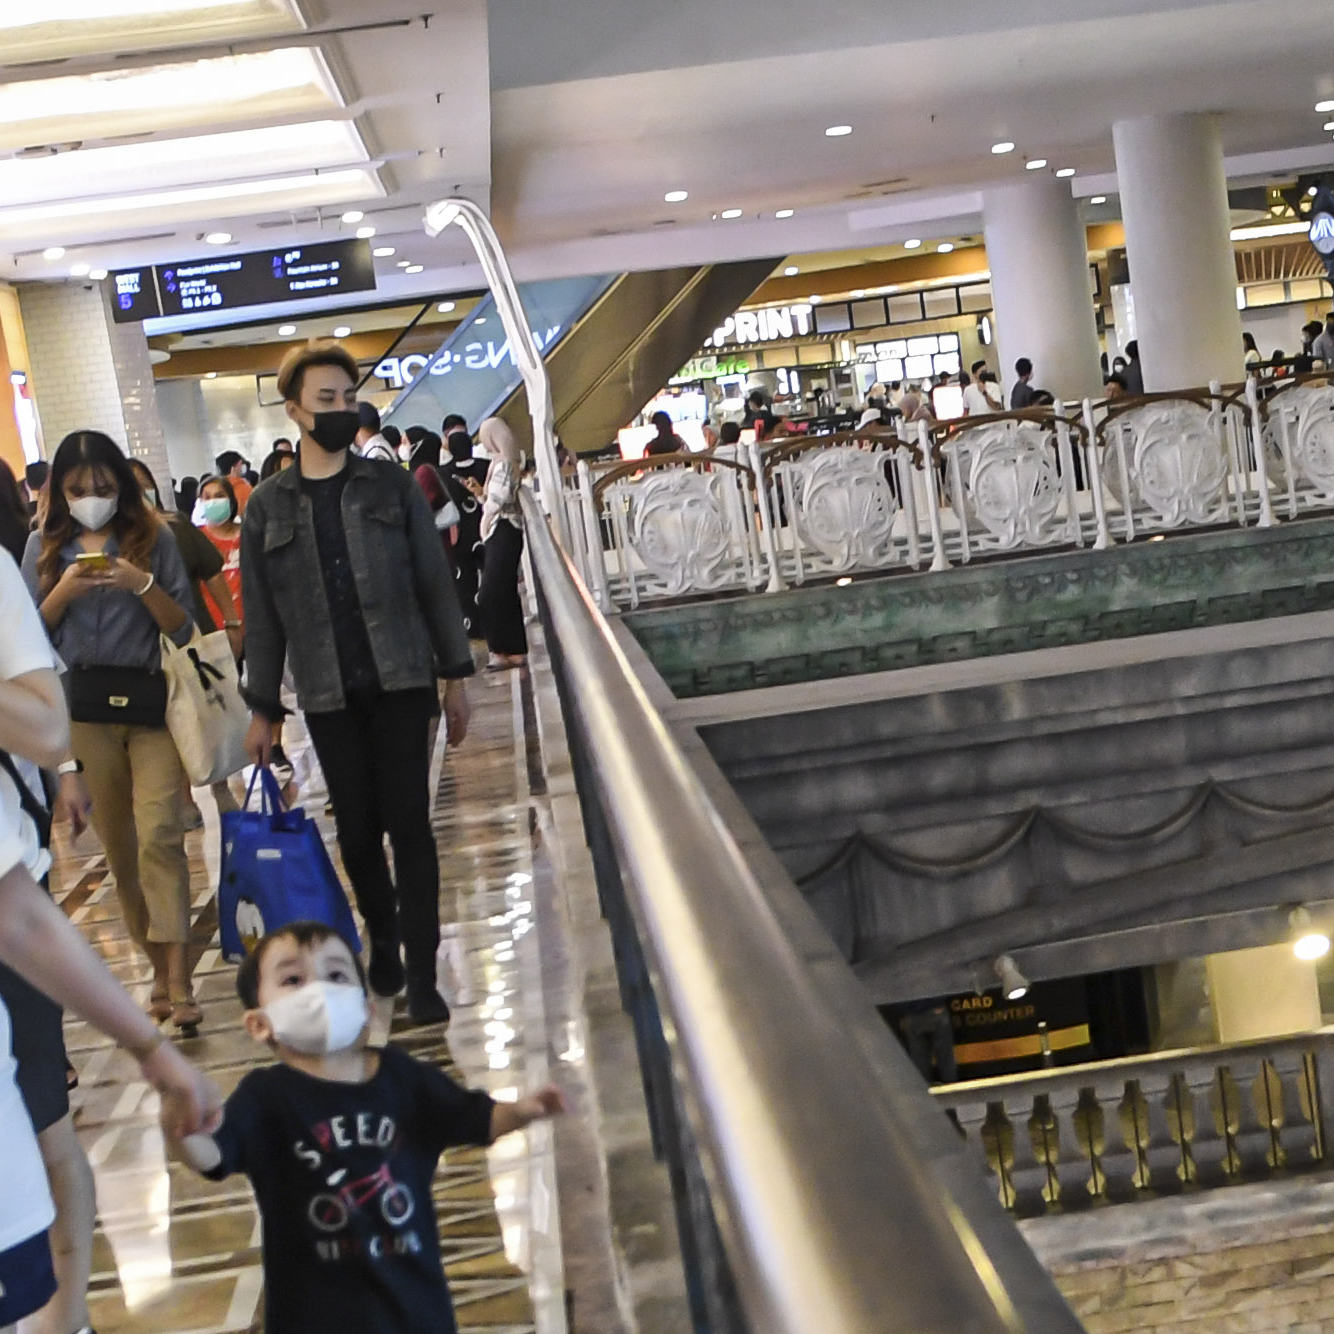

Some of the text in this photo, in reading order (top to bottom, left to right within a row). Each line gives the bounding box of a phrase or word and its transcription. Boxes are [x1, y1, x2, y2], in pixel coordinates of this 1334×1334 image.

[120, 294, 133, 310] 5
[703, 303, 812, 347] PRINT
[951, 996, 993, 1011] CARD
